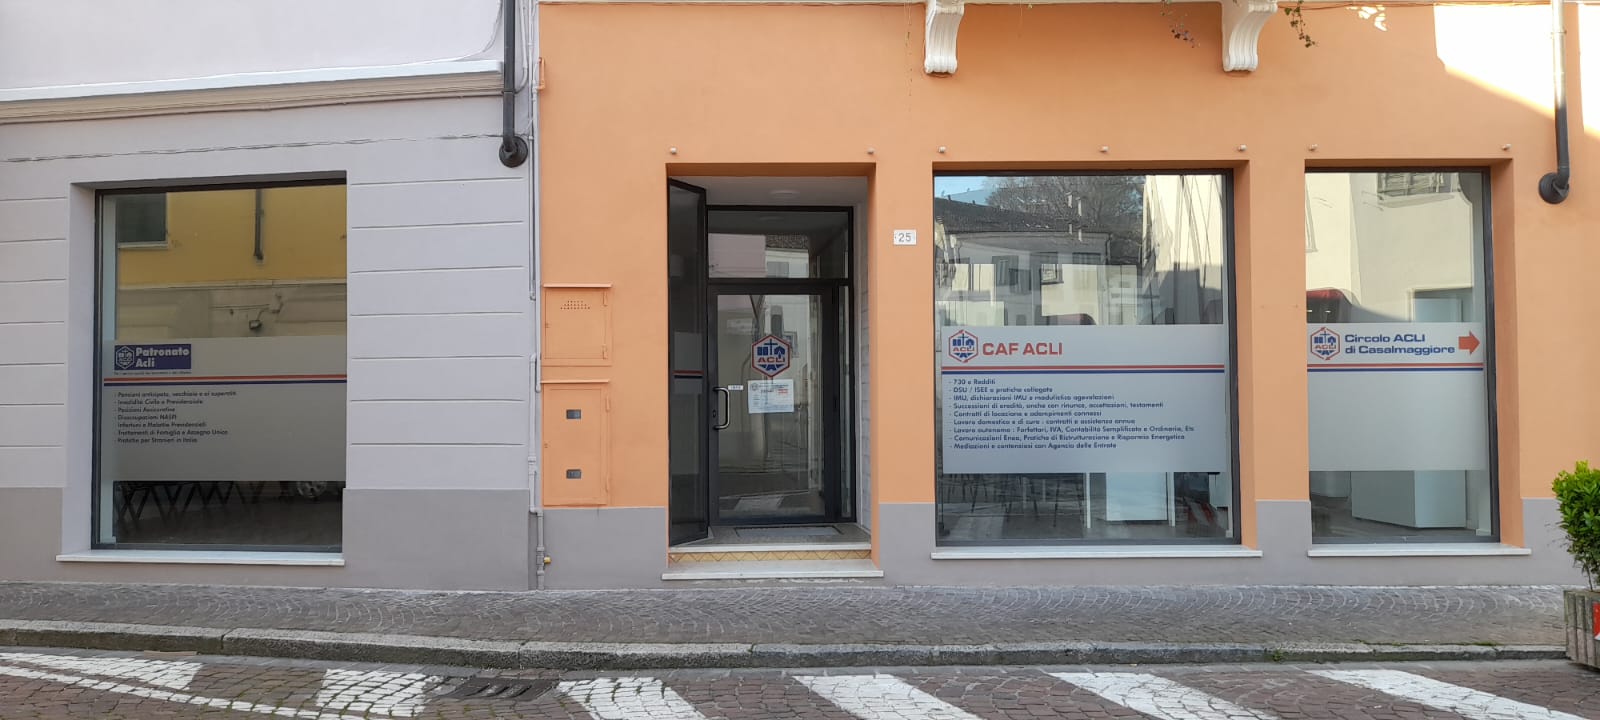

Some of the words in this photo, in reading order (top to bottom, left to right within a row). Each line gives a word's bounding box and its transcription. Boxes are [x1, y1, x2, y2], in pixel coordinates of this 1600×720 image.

[898, 232, 912, 242] 25
[1345, 334, 1390, 342] Circolo
[1394, 334, 1425, 342] ACLI
[136, 347, 190, 356] Patronato
[982, 342, 1019, 356] CAF
[1022, 342, 1062, 356] ACLI
[1345, 346, 1356, 354] di
[1358, 346, 1454, 356] Casalmaggiore
[136, 358, 155, 368] Acli
